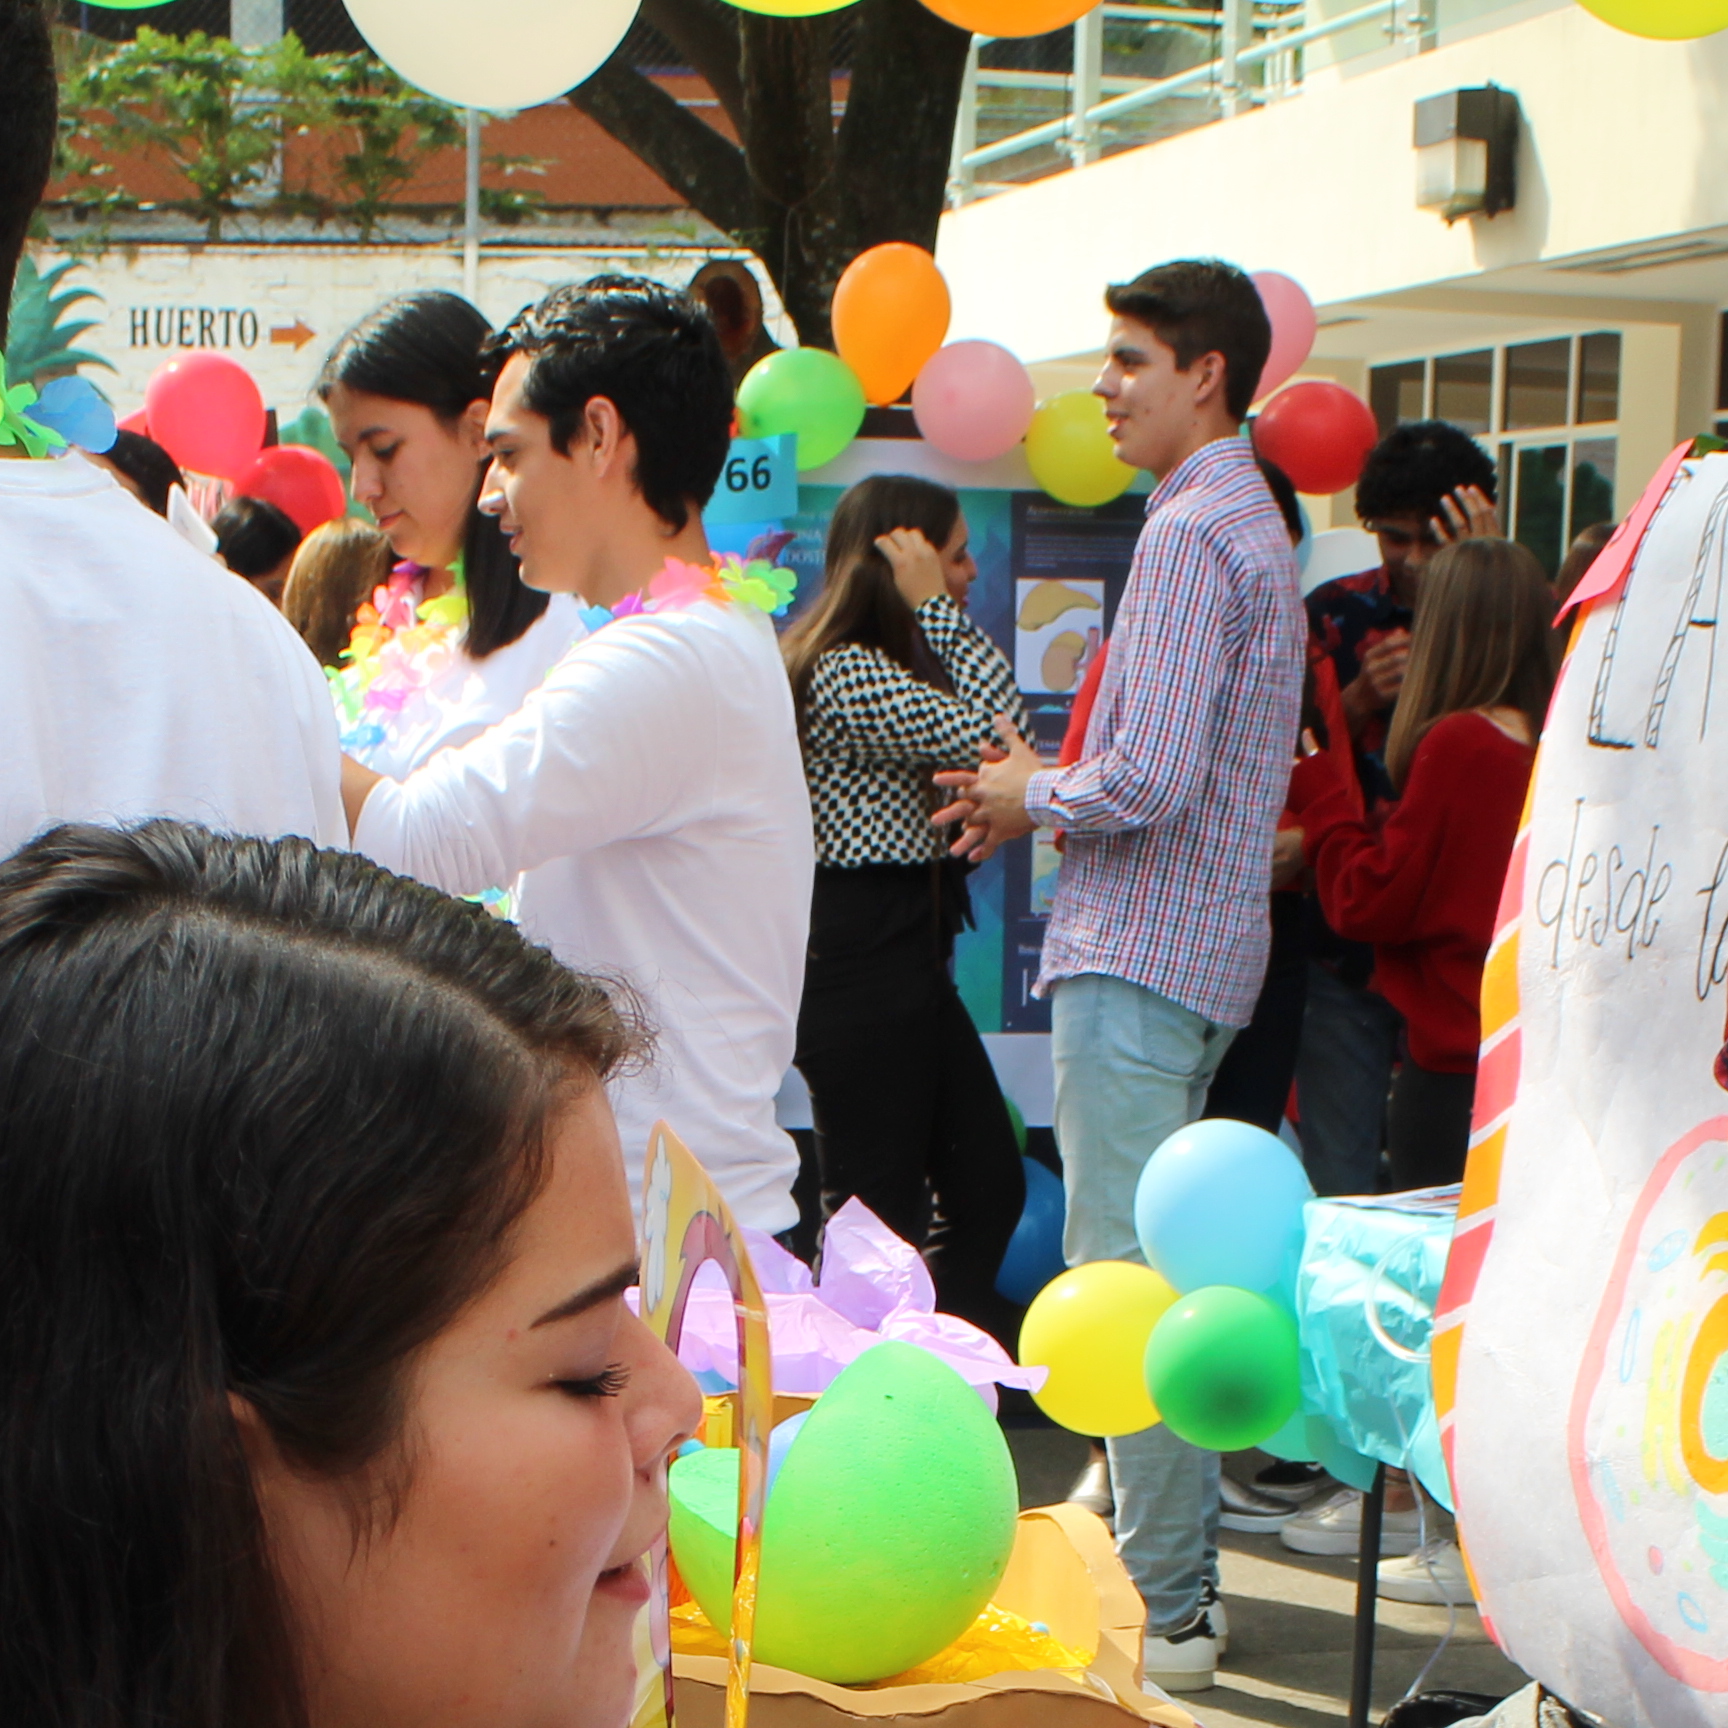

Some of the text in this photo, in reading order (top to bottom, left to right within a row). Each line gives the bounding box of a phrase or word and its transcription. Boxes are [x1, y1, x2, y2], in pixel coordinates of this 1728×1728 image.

[130, 307, 258, 348] HUERTO
[726, 455, 771, 493] 66
[1536, 798, 1673, 969] desde
